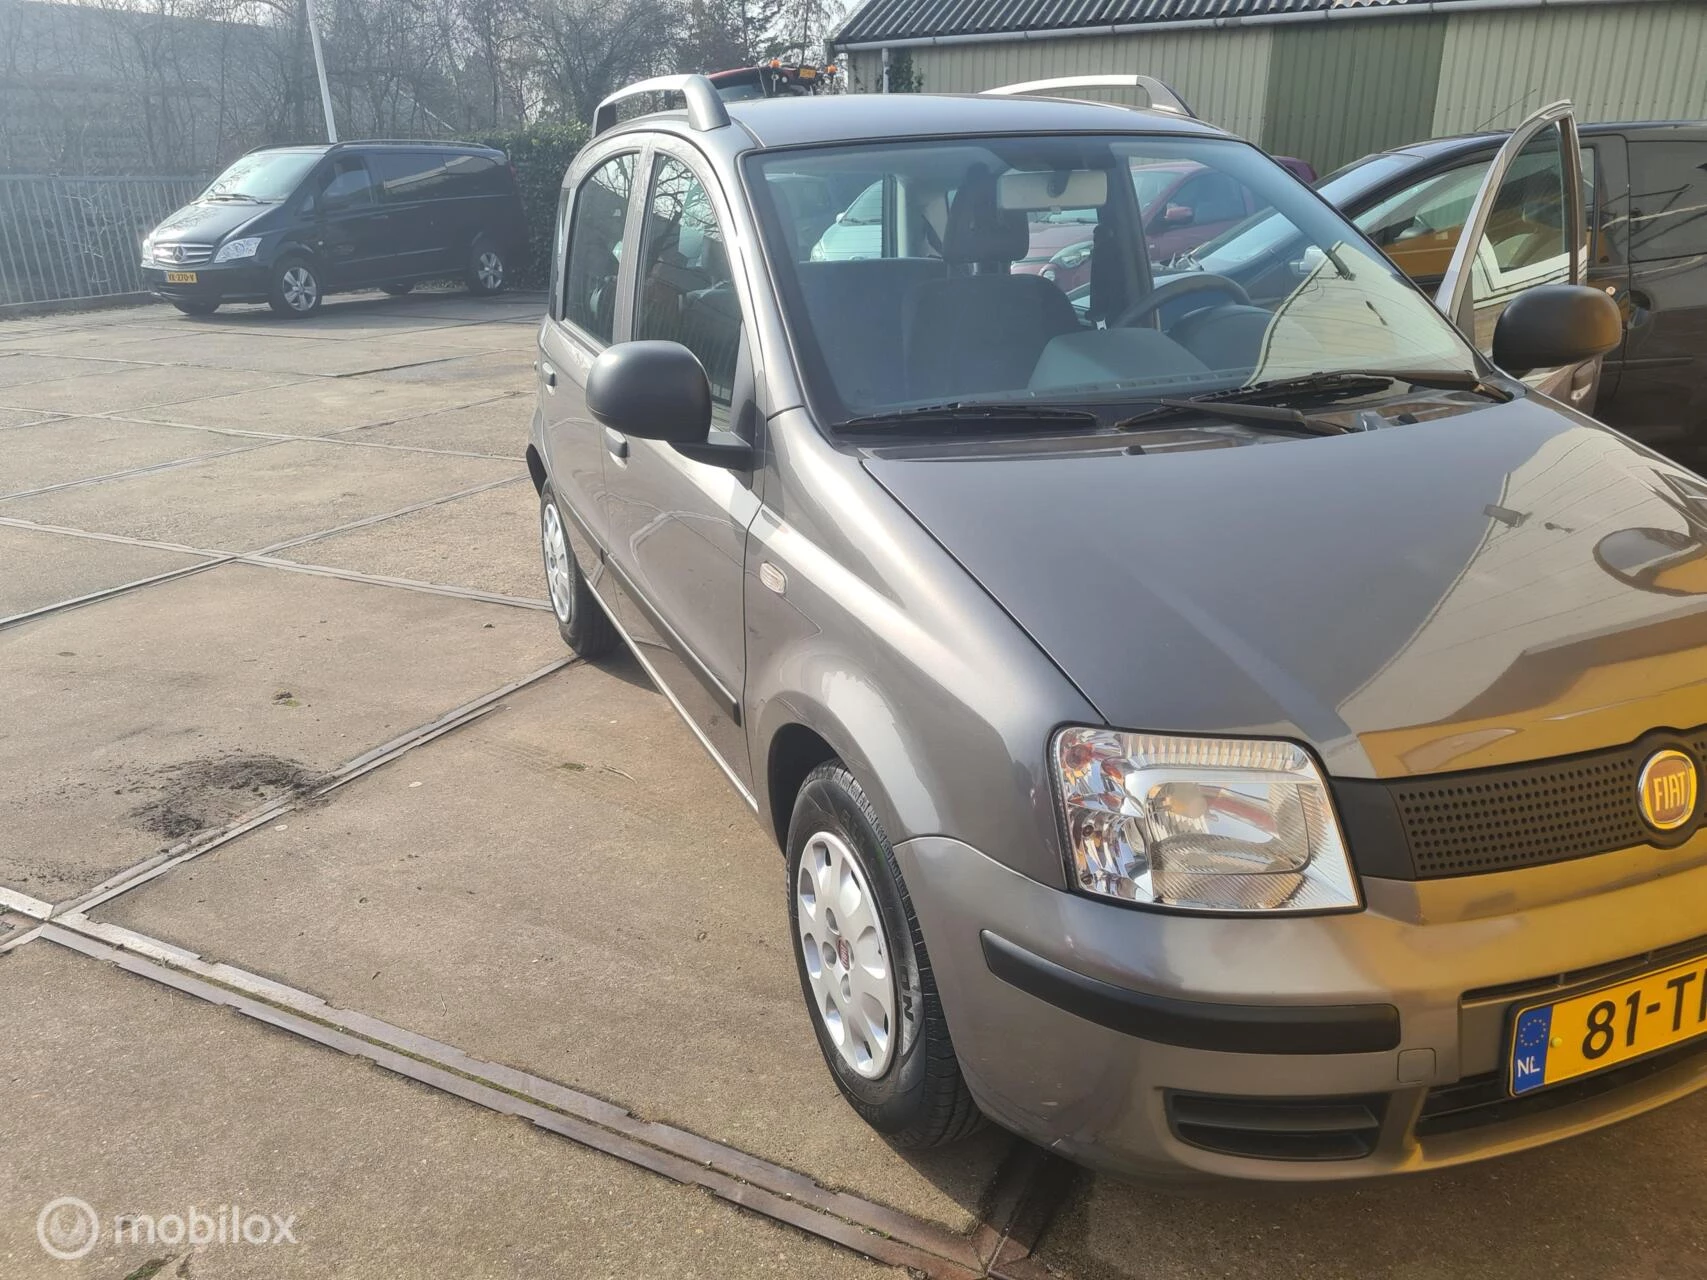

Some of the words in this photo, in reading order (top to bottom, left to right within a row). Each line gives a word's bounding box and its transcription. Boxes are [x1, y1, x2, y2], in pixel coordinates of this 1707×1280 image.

[1653, 771, 1685, 811] FIAT
[1581, 968, 1707, 1061] 81-T
[1517, 1056, 1541, 1078] NL
